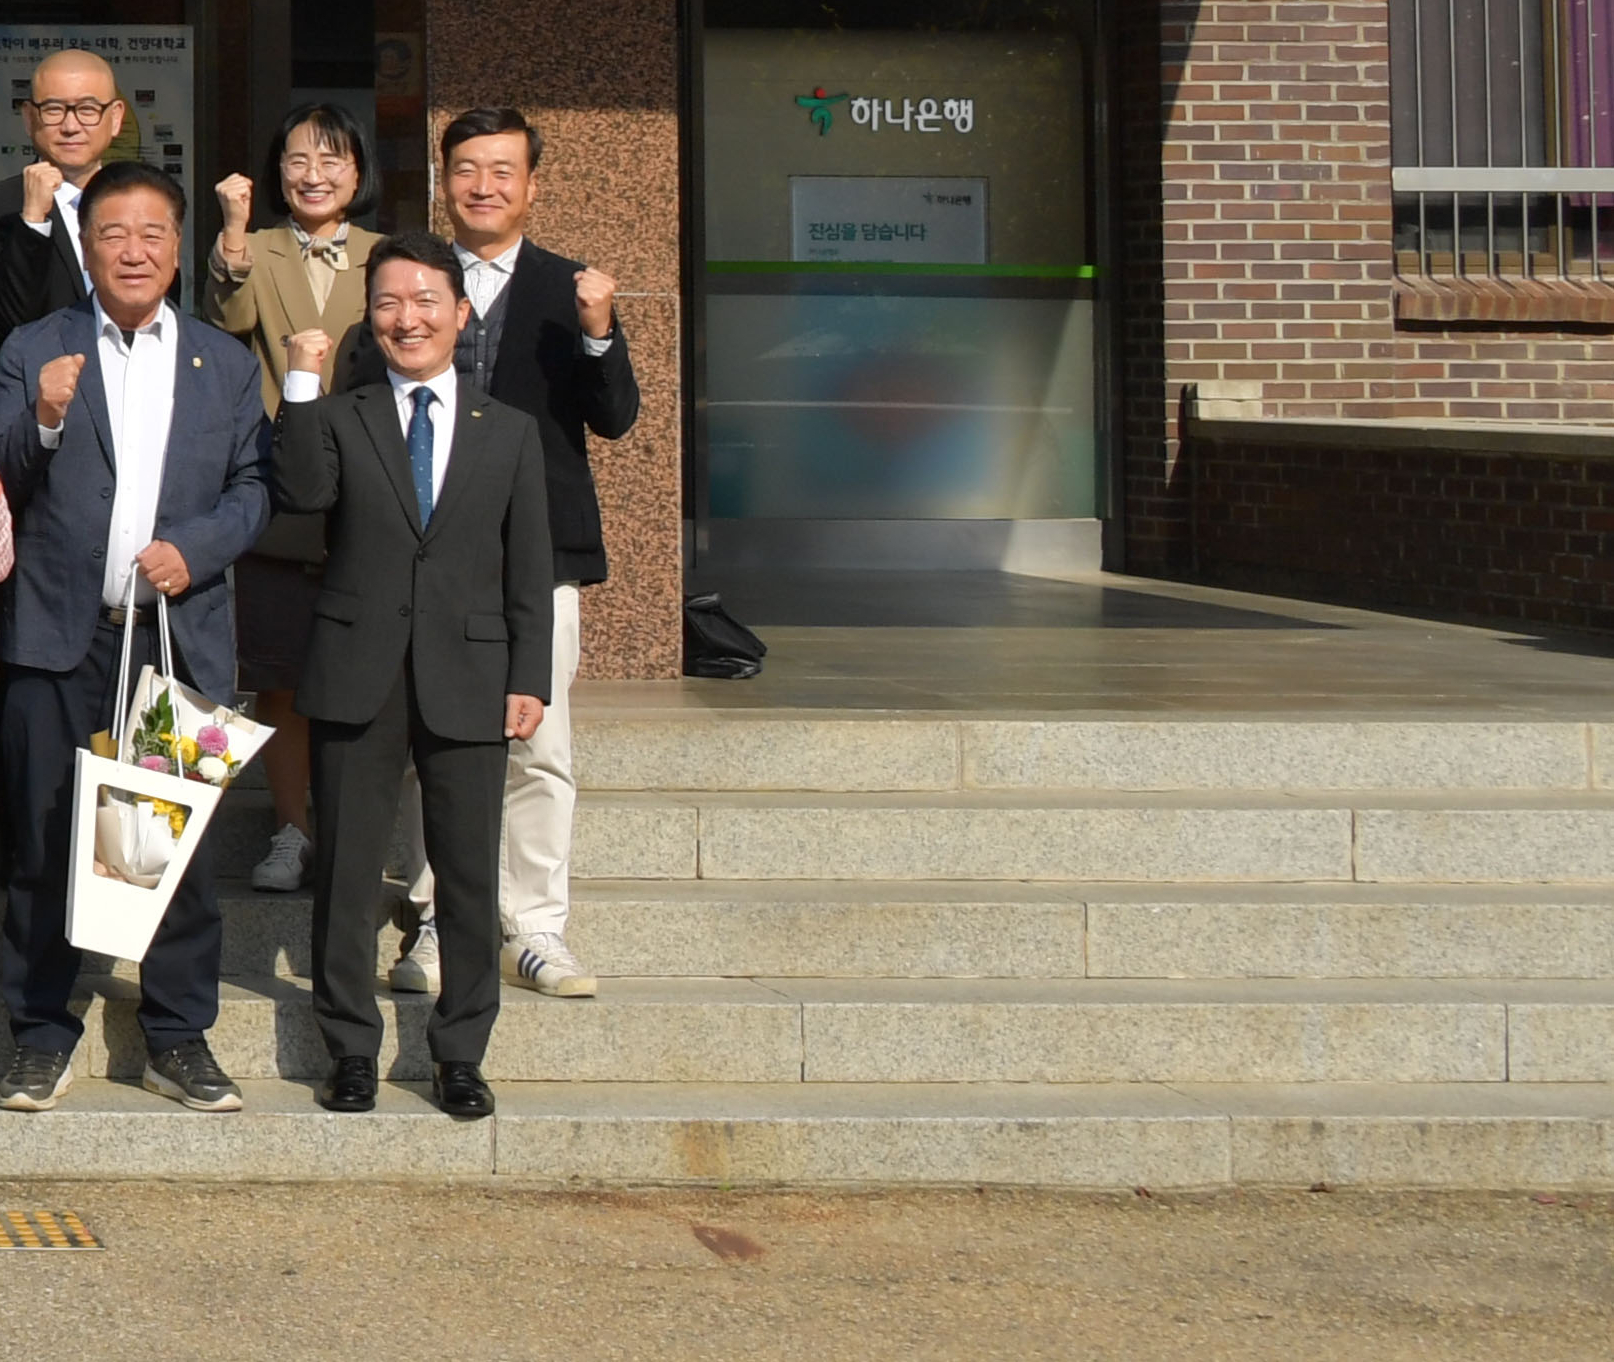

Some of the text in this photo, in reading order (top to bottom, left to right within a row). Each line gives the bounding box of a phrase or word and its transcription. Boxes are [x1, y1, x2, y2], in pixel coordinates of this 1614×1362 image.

[127, 37, 186, 51] 건양대학교
[850, 96, 975, 134] 하나은행
[808, 222, 927, 241] 진심을 담습니다
